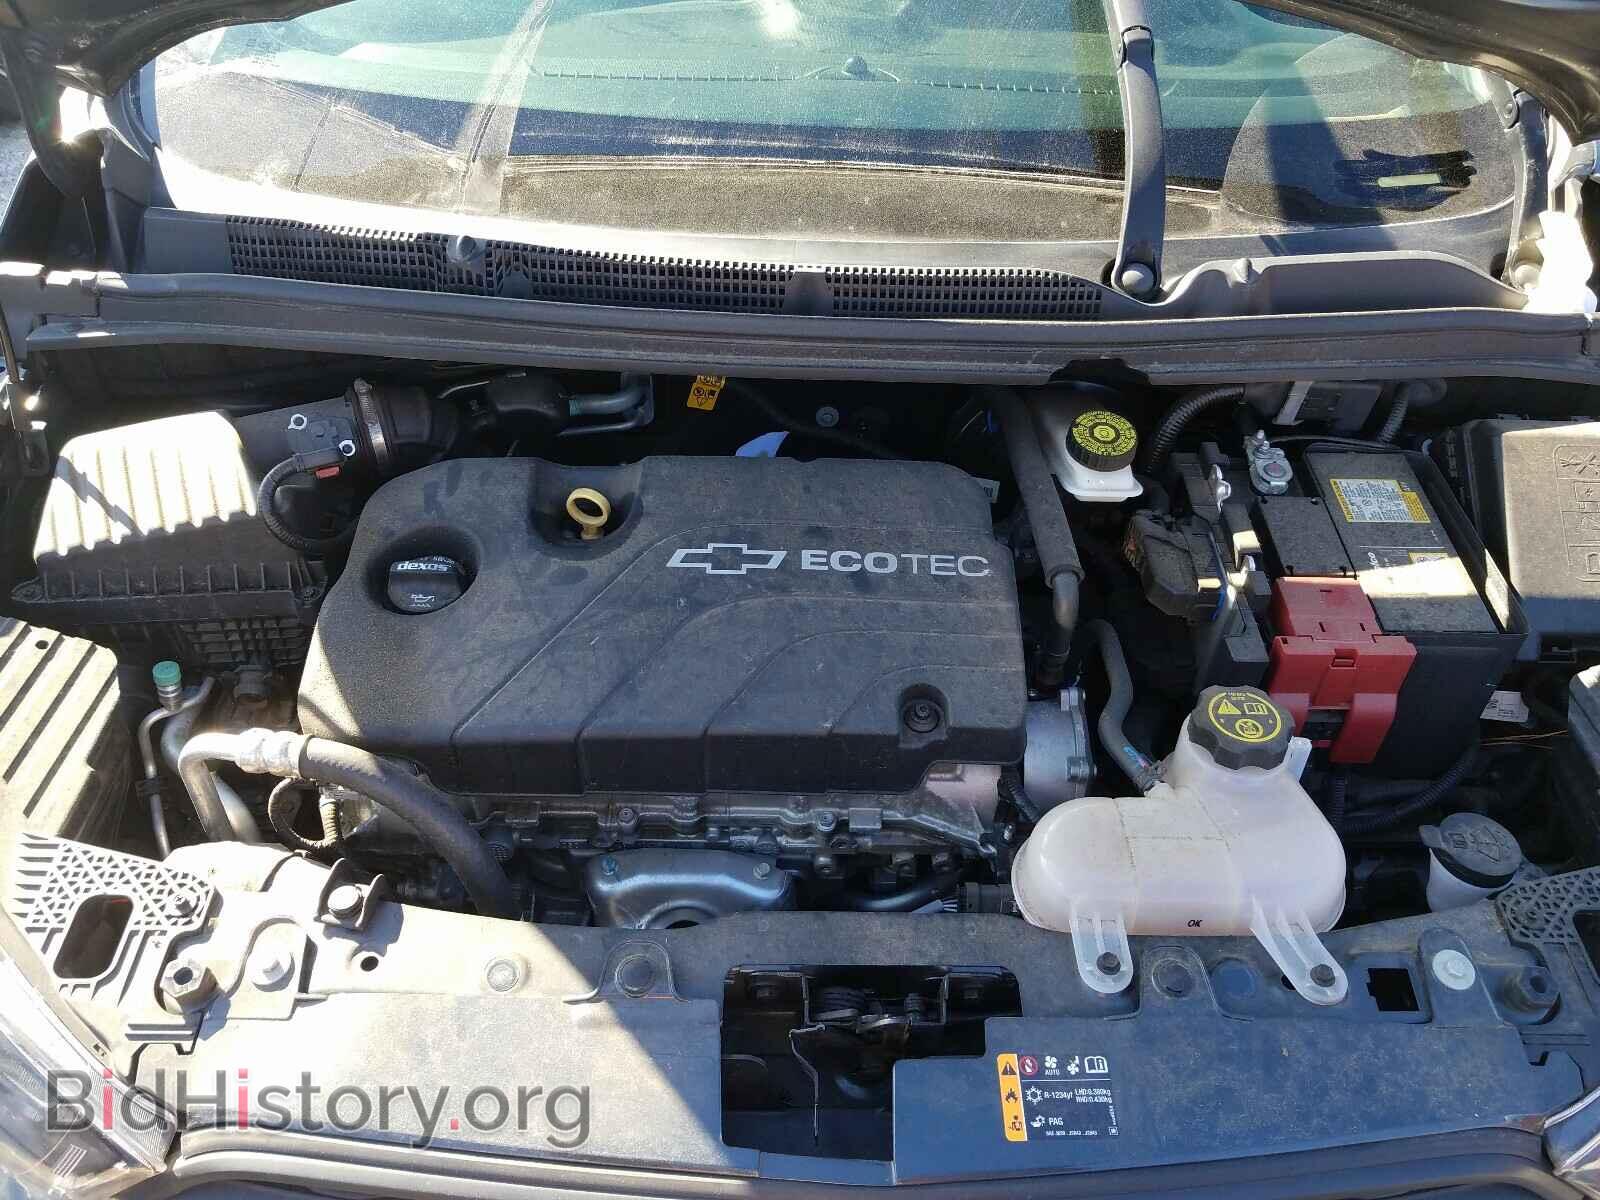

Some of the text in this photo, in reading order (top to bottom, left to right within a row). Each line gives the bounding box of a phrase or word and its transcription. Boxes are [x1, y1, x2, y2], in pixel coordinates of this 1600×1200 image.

[397, 561, 449, 572] dexos
[801, 549, 990, 577] ECOTEC
[1187, 919, 1203, 928] OK
[1048, 1117, 1064, 1126] PAG
